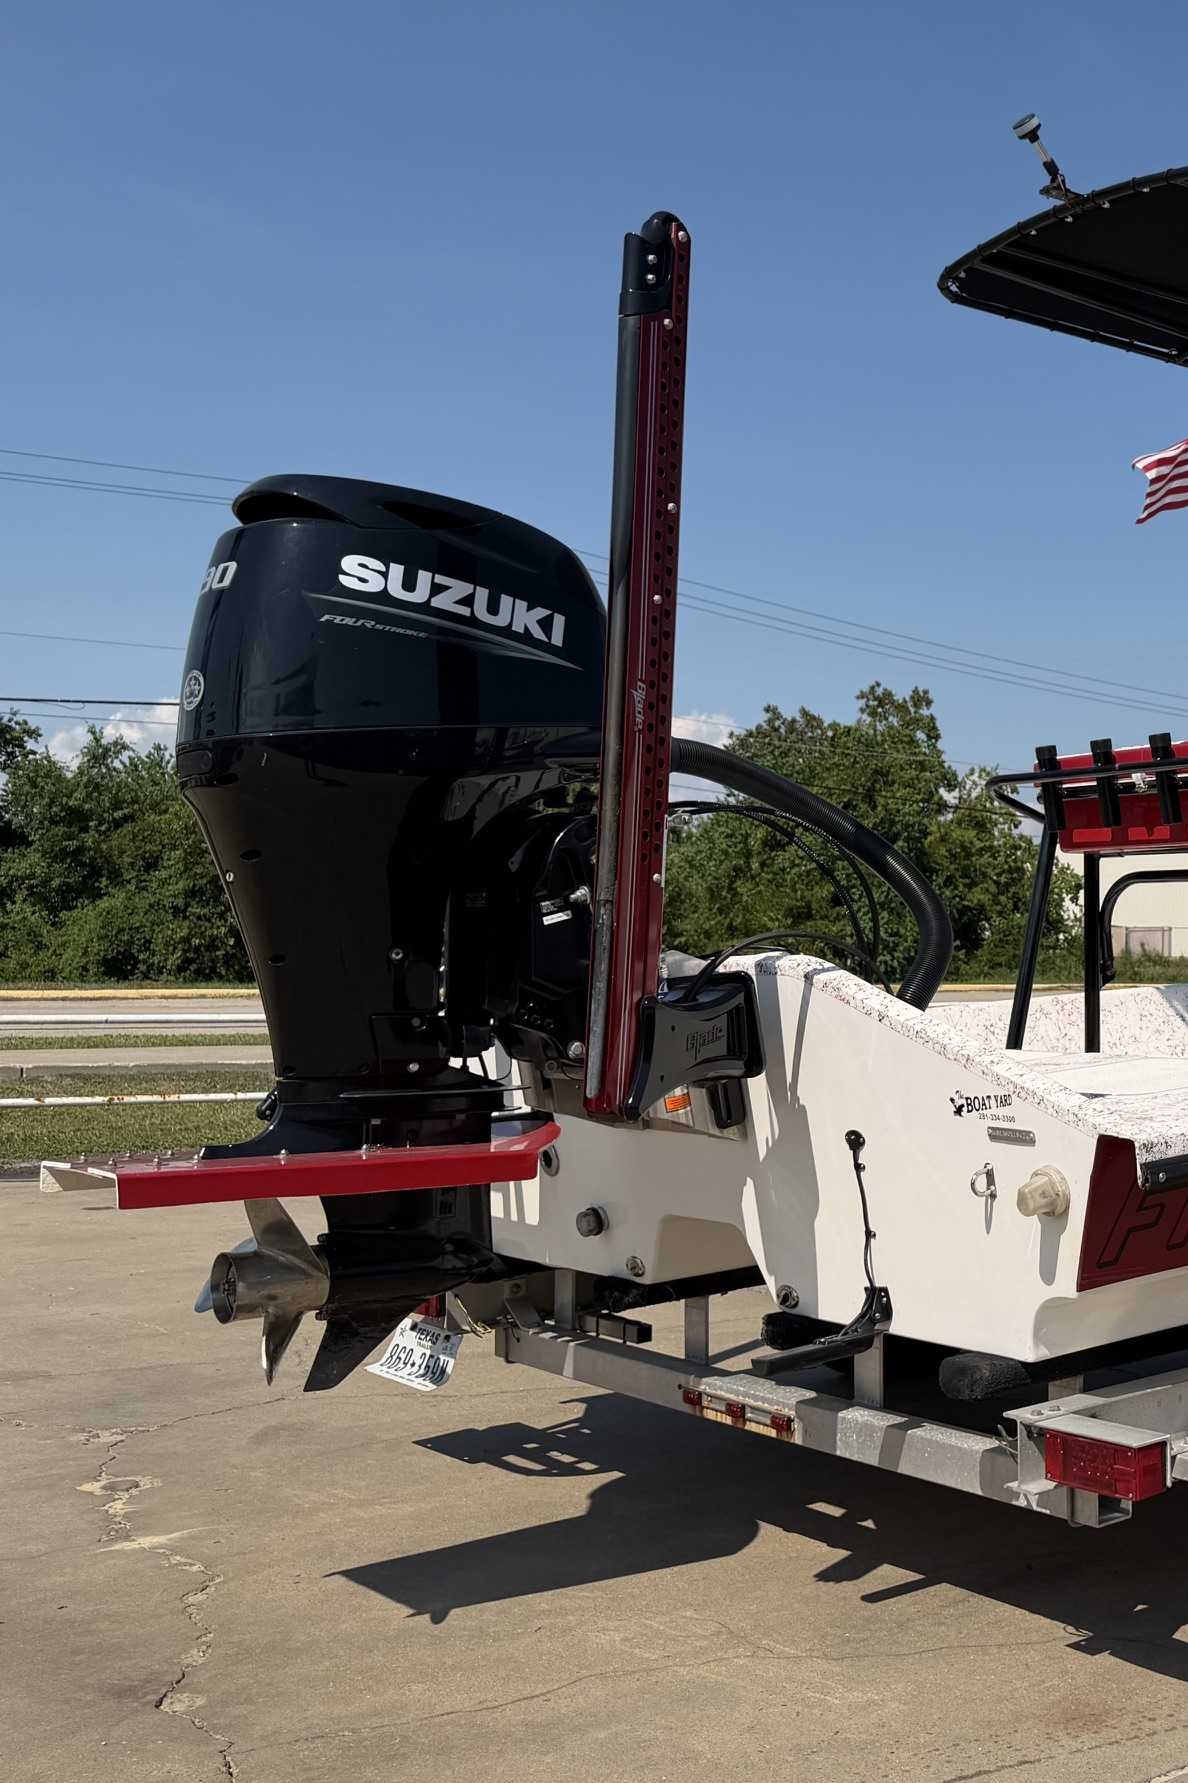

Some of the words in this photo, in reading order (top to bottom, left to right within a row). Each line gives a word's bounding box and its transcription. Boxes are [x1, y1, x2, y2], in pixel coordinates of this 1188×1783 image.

[338, 554, 566, 648] SUZUKI
[965, 1095, 992, 1114] BOAT
[993, 1093, 1013, 1109] YARD
[415, 1328, 441, 1345] TEXAS
